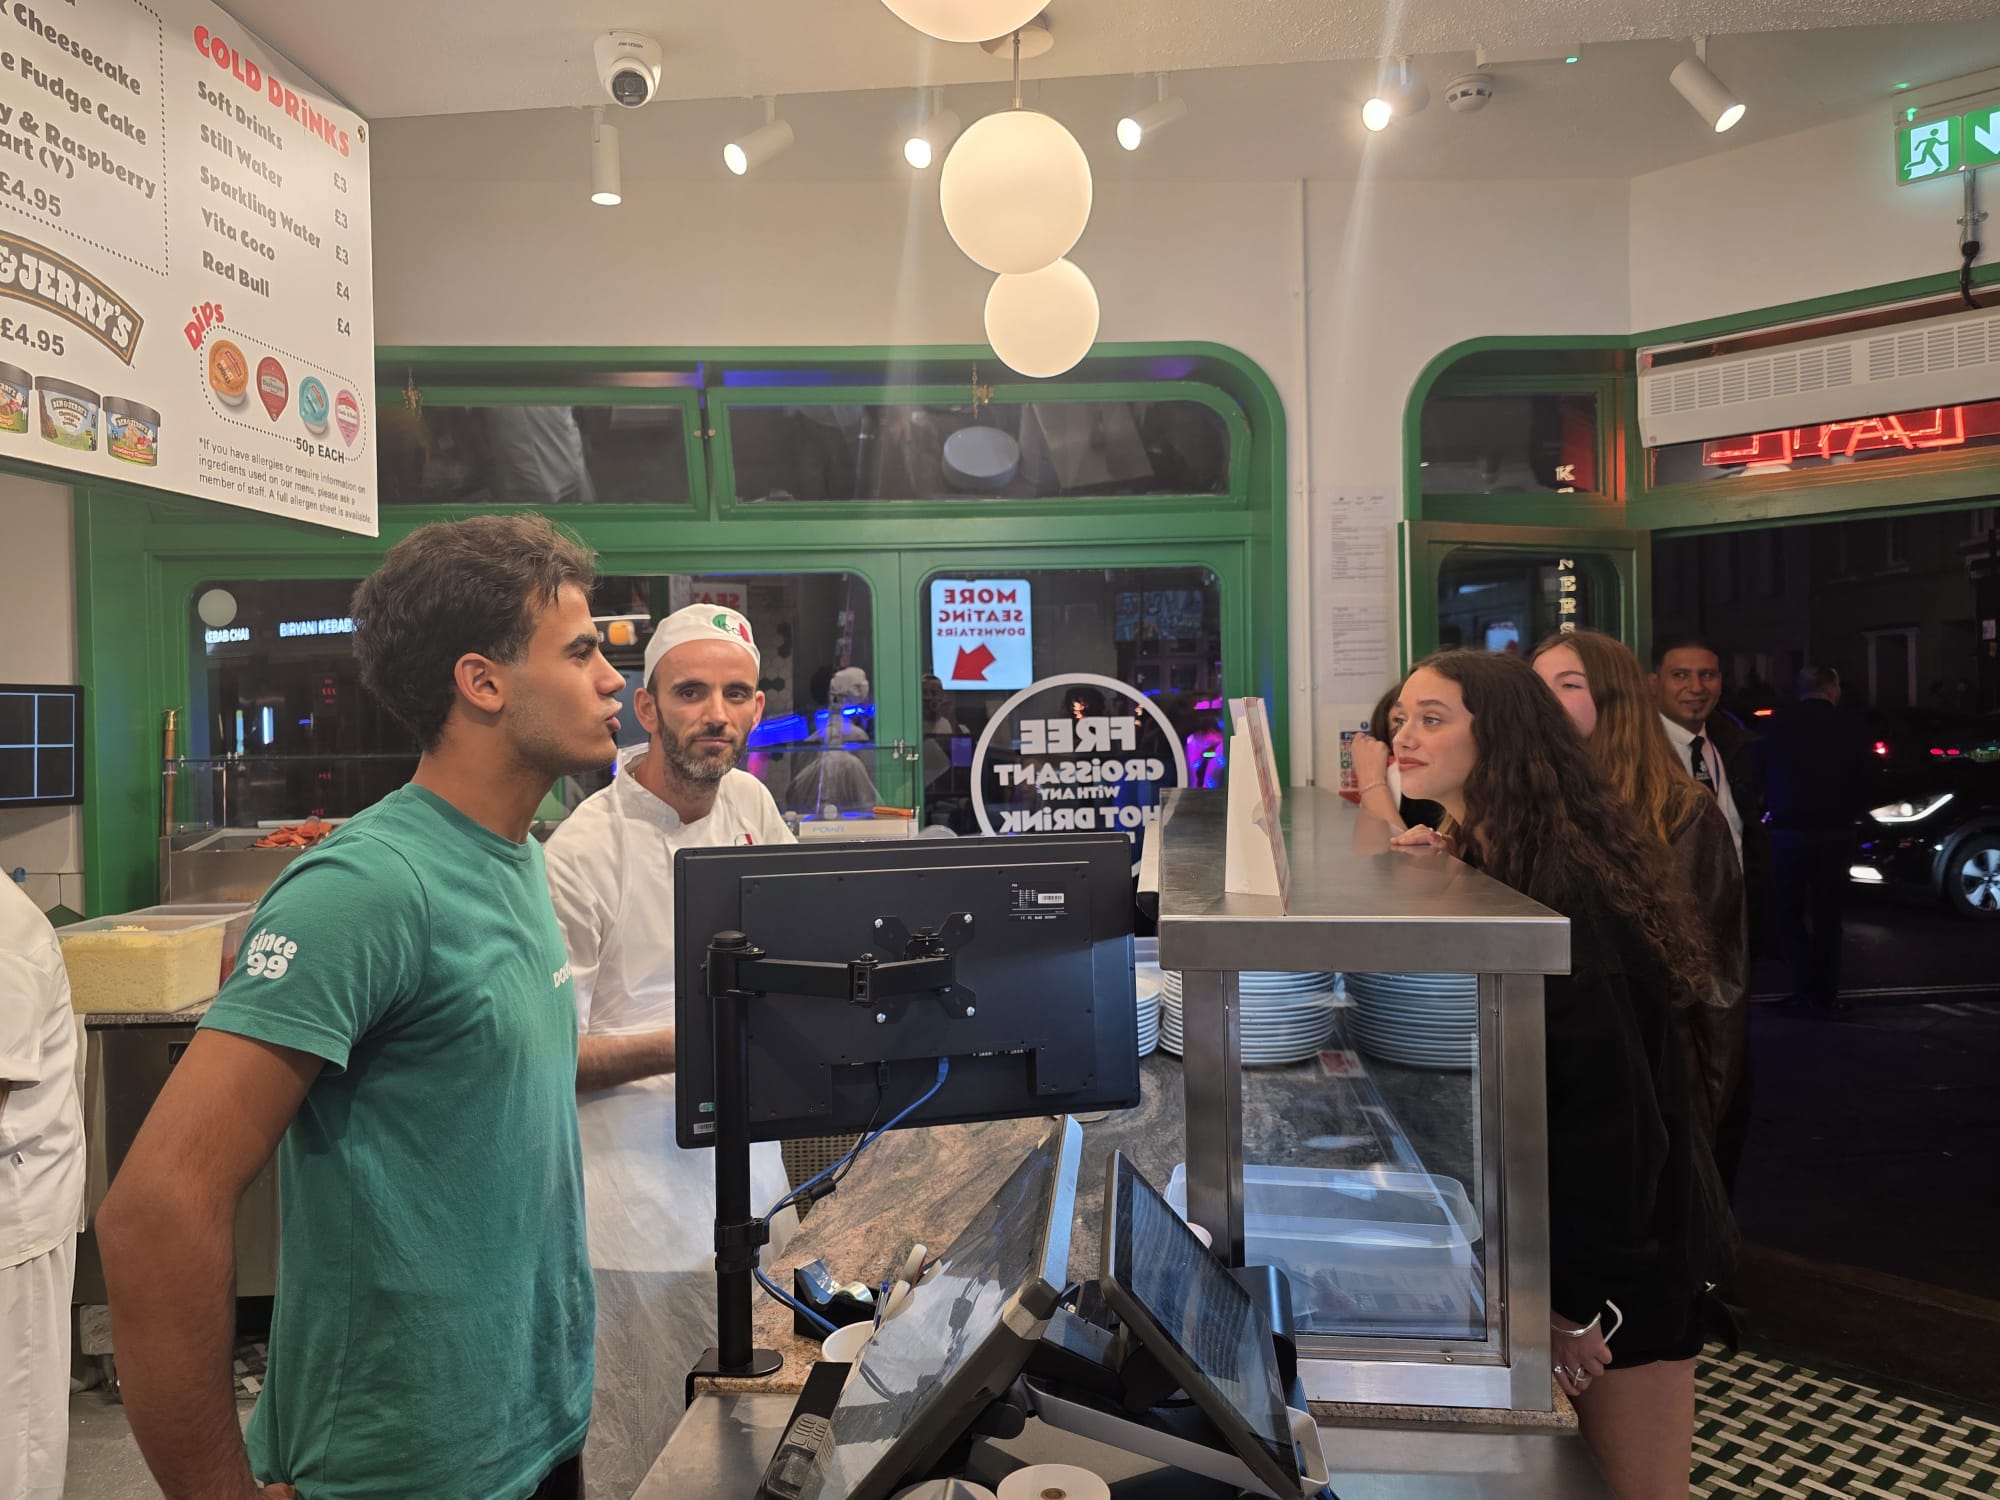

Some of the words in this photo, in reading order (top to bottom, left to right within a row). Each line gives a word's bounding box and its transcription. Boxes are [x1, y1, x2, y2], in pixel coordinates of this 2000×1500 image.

[14, 3, 141, 95] Cheesecake
[194, 25, 262, 92] COLD
[21, 57, 92, 114] Fudge
[97, 103, 146, 145] Cake
[19, 111, 40, 138] &
[45, 122, 156, 199] Raspberry
[39, 146, 74, 179] (V)
[198, 81, 232, 118] Soft
[236, 105, 283, 150] Drinks
[334, 172, 347, 193] £3
[0, 171, 61, 217] £4.95
[200, 124, 233, 158] Still
[237, 145, 282, 187] Water
[335, 209, 348, 229] £3
[200, 165, 277, 228] Sparkling
[280, 211, 320, 248] Water
[335, 245, 349, 265] £3
[201, 207, 237, 242] Vita
[241, 230, 275, 261] Coco
[336, 281, 350, 301] £4
[203, 250, 235, 281] Red
[239, 268, 270, 298] Bull
[337, 318, 351, 336] £4
[1, 318, 65, 356] £4.95
[212, 443, 227, 454] you
[230, 446, 249, 461] have
[252, 453, 284, 470] allergies
[295, 467, 320, 480] require
[321, 472, 357, 491] information
[296, 437, 315, 457] 50p
[318, 445, 345, 464] EACH
[199, 453, 246, 476] ingredients
[248, 469, 267, 481] used
[269, 475, 279, 484] on
[281, 479, 293, 488] our
[295, 482, 316, 496] menu,
[318, 487, 338, 501] please
[340, 494, 350, 504] ask
[199, 474, 235, 489] member
[237, 482, 246, 492] of
[247, 485, 267, 498] staff.
[268, 489, 275, 499] A
[276, 490, 289, 504] full
[290, 493, 318, 510] allergen
[320, 502, 337, 515] sheet
[280, 621, 318, 637] BIRYANI
[246, 952, 289, 979] 99
[247, 928, 298, 959] since
